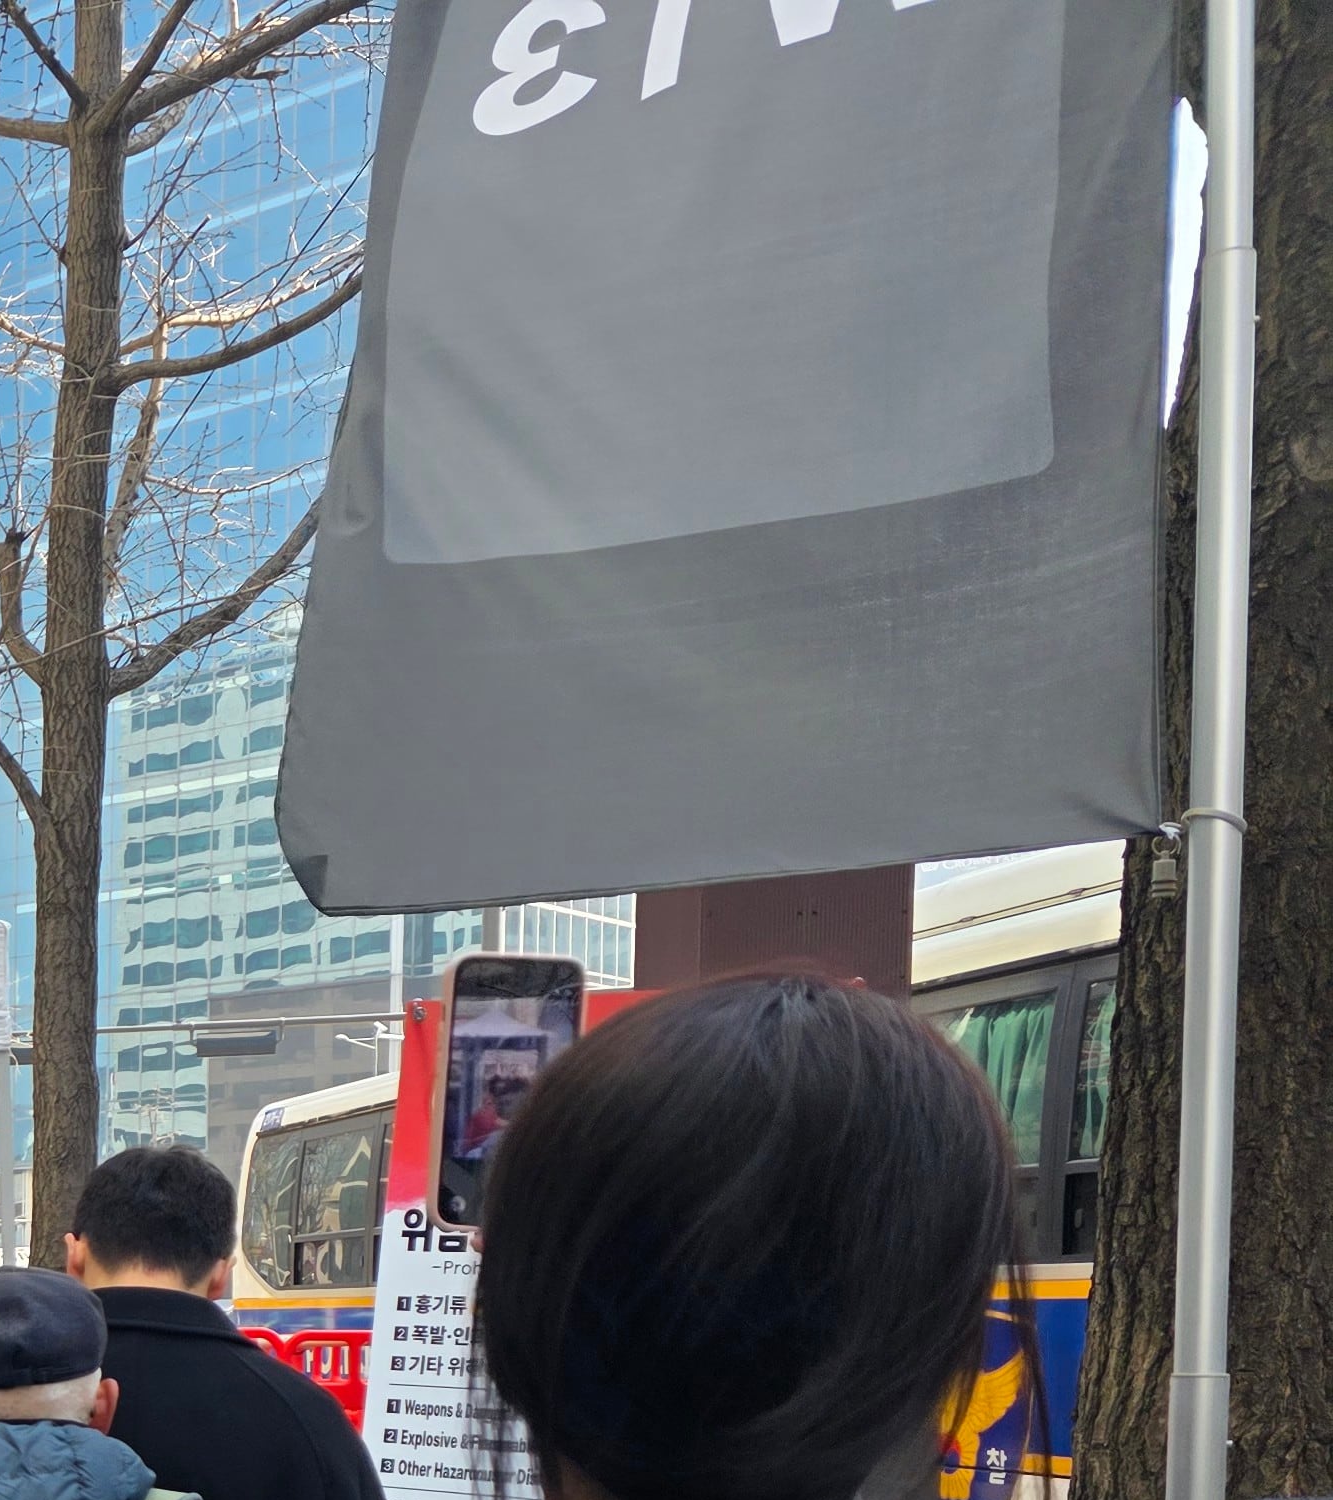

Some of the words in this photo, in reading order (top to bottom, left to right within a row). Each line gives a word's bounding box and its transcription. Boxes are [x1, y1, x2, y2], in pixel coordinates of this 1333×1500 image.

[414, 1294, 468, 1315] 흉기류
[408, 1355, 444, 1376] 기타
[404, 1398, 454, 1420] Weapons
[455, 1402, 463, 1418] &
[400, 1429, 458, 1451] Explosive
[398, 1459, 432, 1478] Other
[986, 1447, 1008, 1485] 찰
